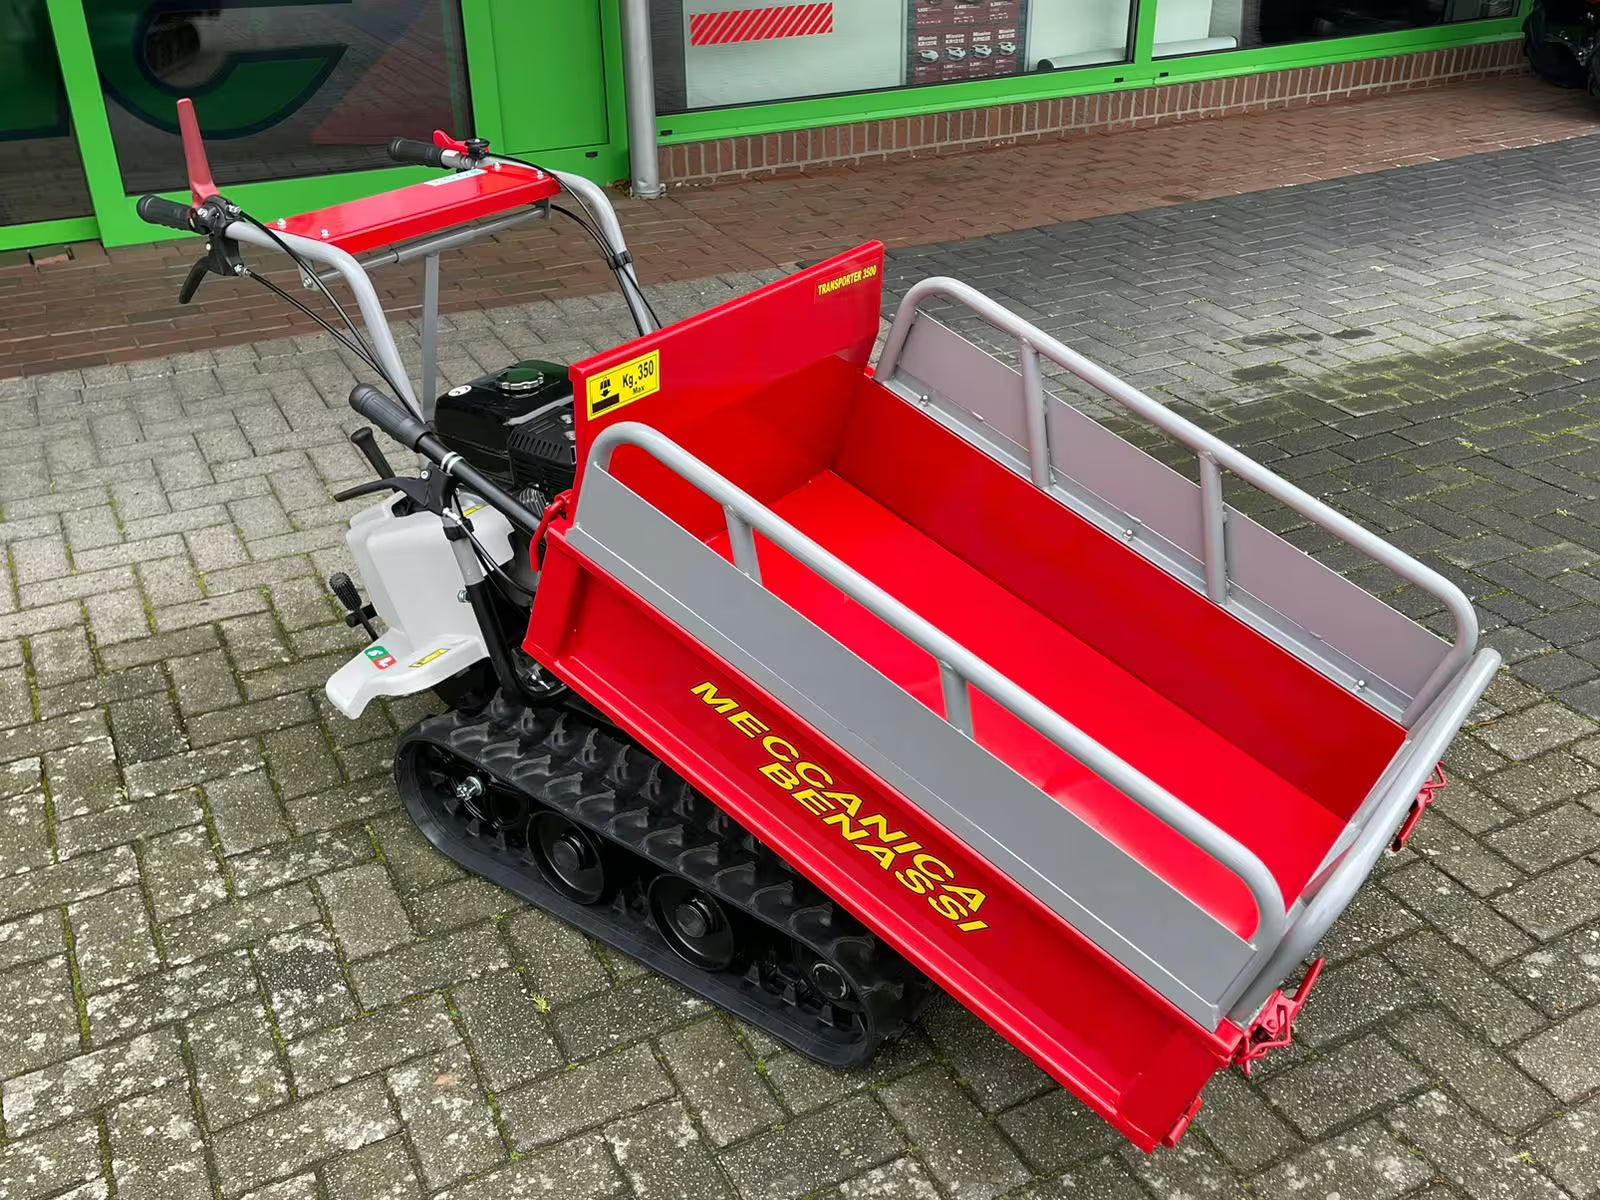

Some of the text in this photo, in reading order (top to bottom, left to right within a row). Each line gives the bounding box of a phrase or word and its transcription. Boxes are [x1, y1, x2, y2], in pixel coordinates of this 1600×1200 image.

[818, 270, 862, 296] TRANSPORTER
[633, 386, 645, 394] Max
[690, 681, 987, 913] MECCANICA
[758, 762, 989, 933] BENASSI
